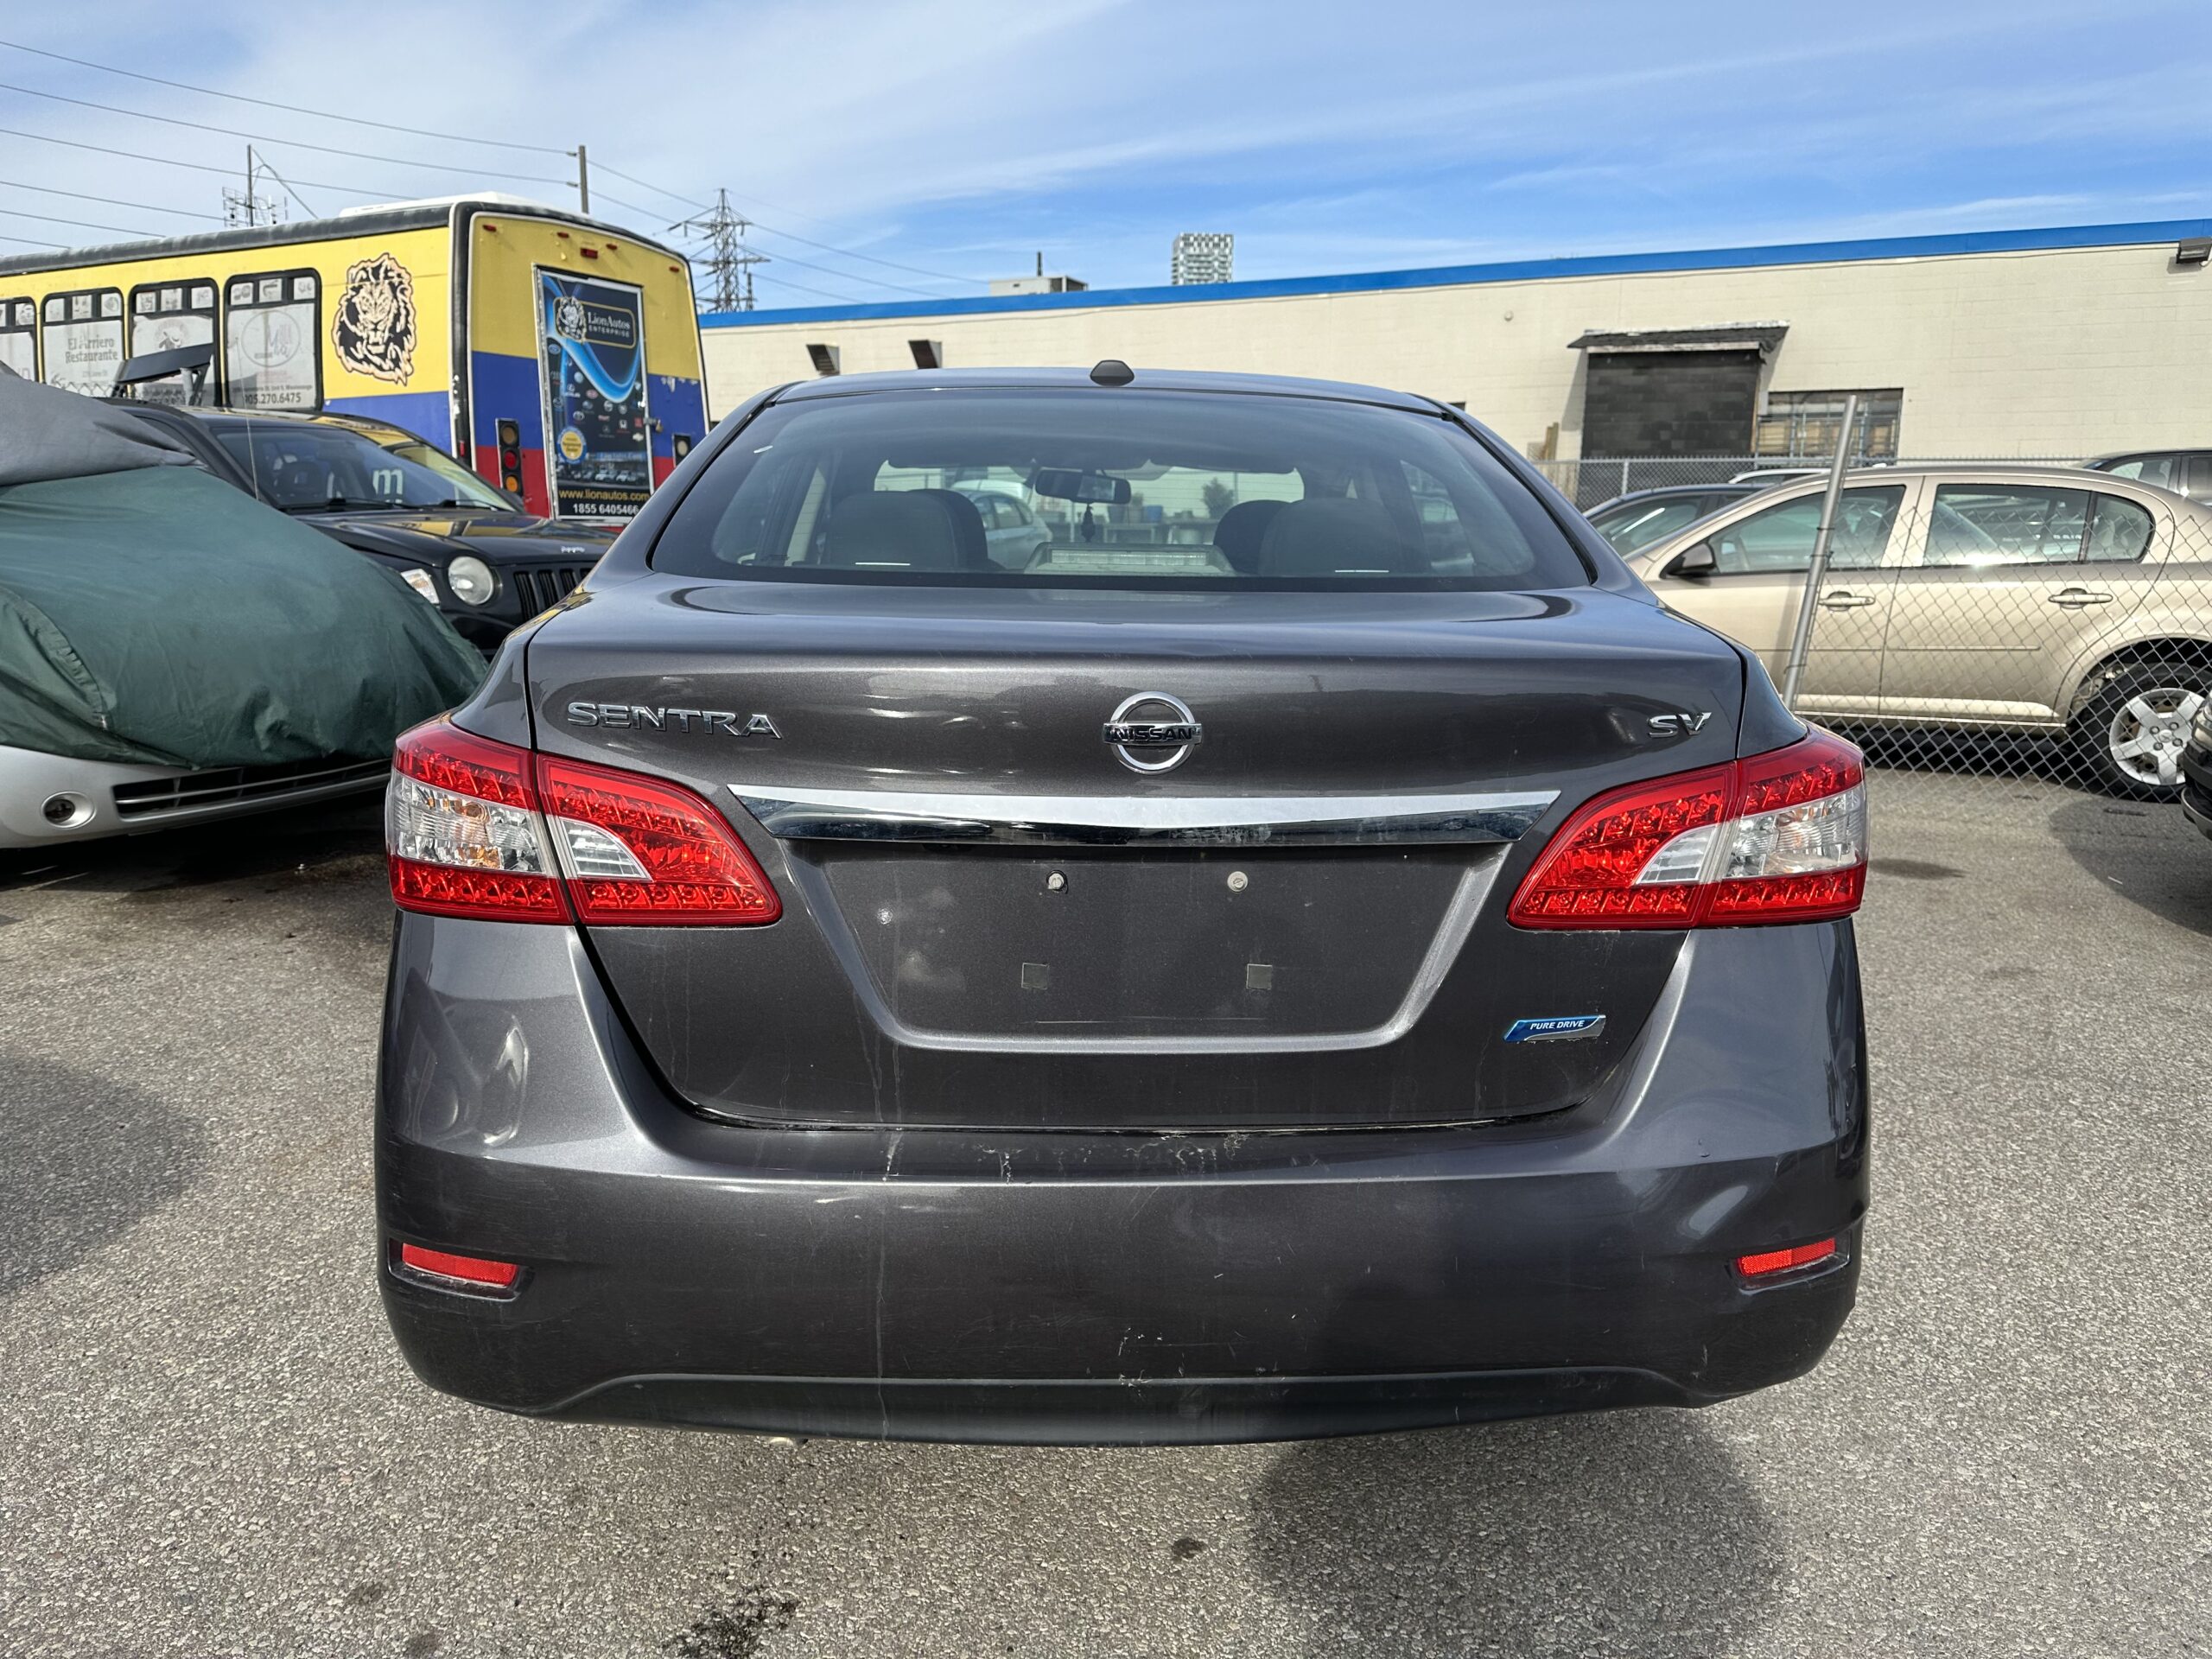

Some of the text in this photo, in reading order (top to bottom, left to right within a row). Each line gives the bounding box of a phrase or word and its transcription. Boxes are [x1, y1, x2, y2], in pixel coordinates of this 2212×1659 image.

[65, 349, 118, 364] Restaurante
[559, 489, 650, 501] www.lionautos.com
[573, 503, 597, 514] 1855
[567, 701, 783, 740] SENTRA
[1647, 711, 1713, 739] SV
[1111, 728, 1192, 741] NISSAN
[1529, 1020, 1586, 1031] PURE DRIVE
